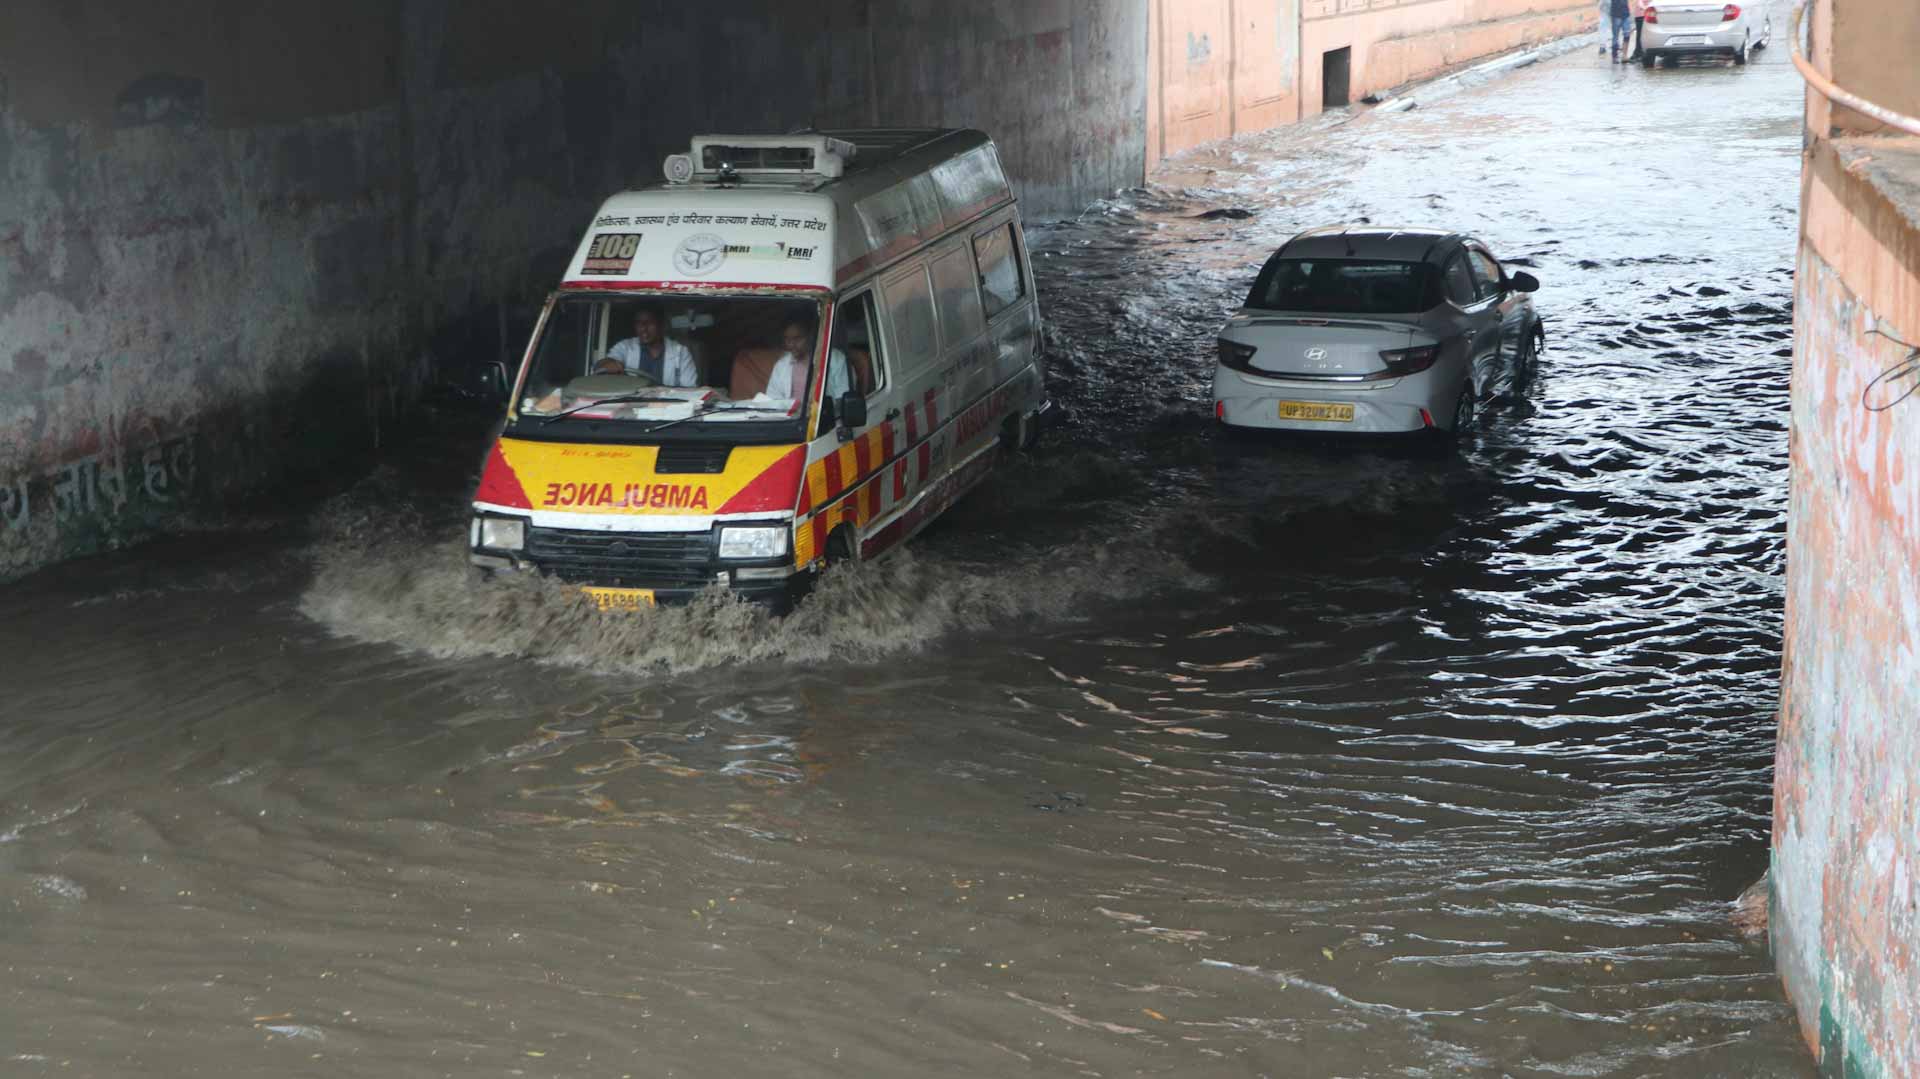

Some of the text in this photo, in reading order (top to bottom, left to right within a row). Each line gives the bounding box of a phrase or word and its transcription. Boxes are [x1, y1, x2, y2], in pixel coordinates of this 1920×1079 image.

[683, 212, 713, 224] परिवार
[715, 215, 748, 225] कल्याण
[780, 217, 801, 229] उत्तर
[803, 217, 828, 232] प्रदेश
[594, 234, 640, 258] 108
[722, 244, 751, 254] EMRI
[786, 247, 813, 258] EMRI
